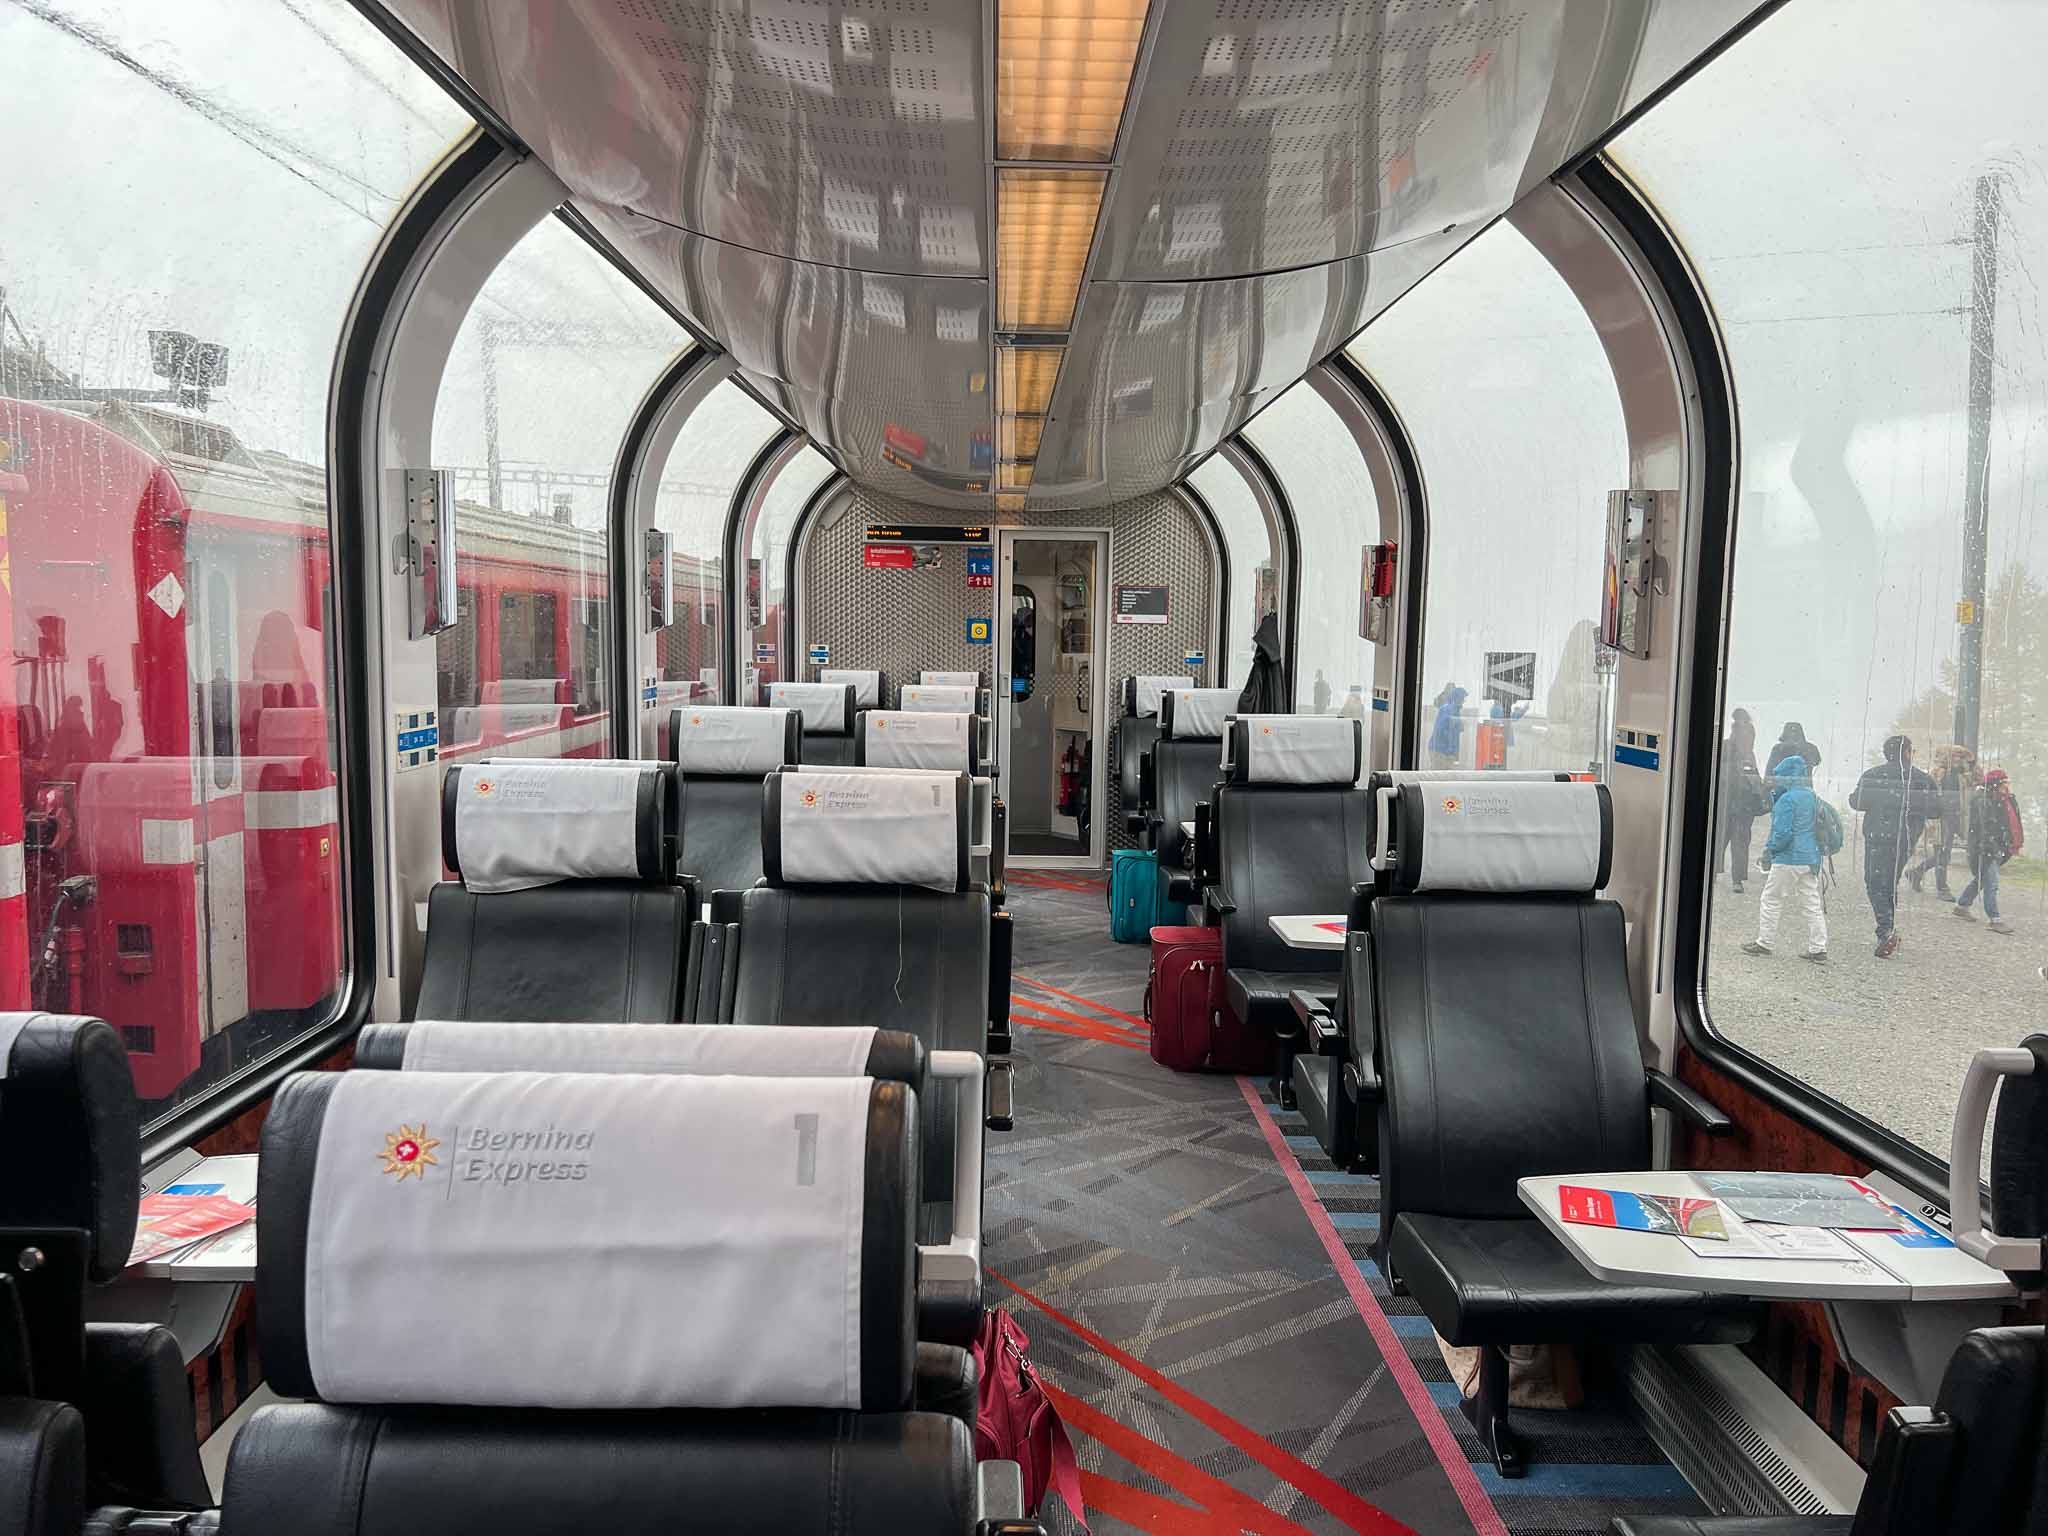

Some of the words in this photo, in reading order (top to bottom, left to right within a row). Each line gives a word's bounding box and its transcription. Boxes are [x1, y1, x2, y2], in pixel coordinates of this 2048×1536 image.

[930, 784, 942, 807] 1
[467, 1123, 594, 1152] Bernina
[793, 1113, 819, 1186] 1
[463, 1158, 590, 1186] Express
